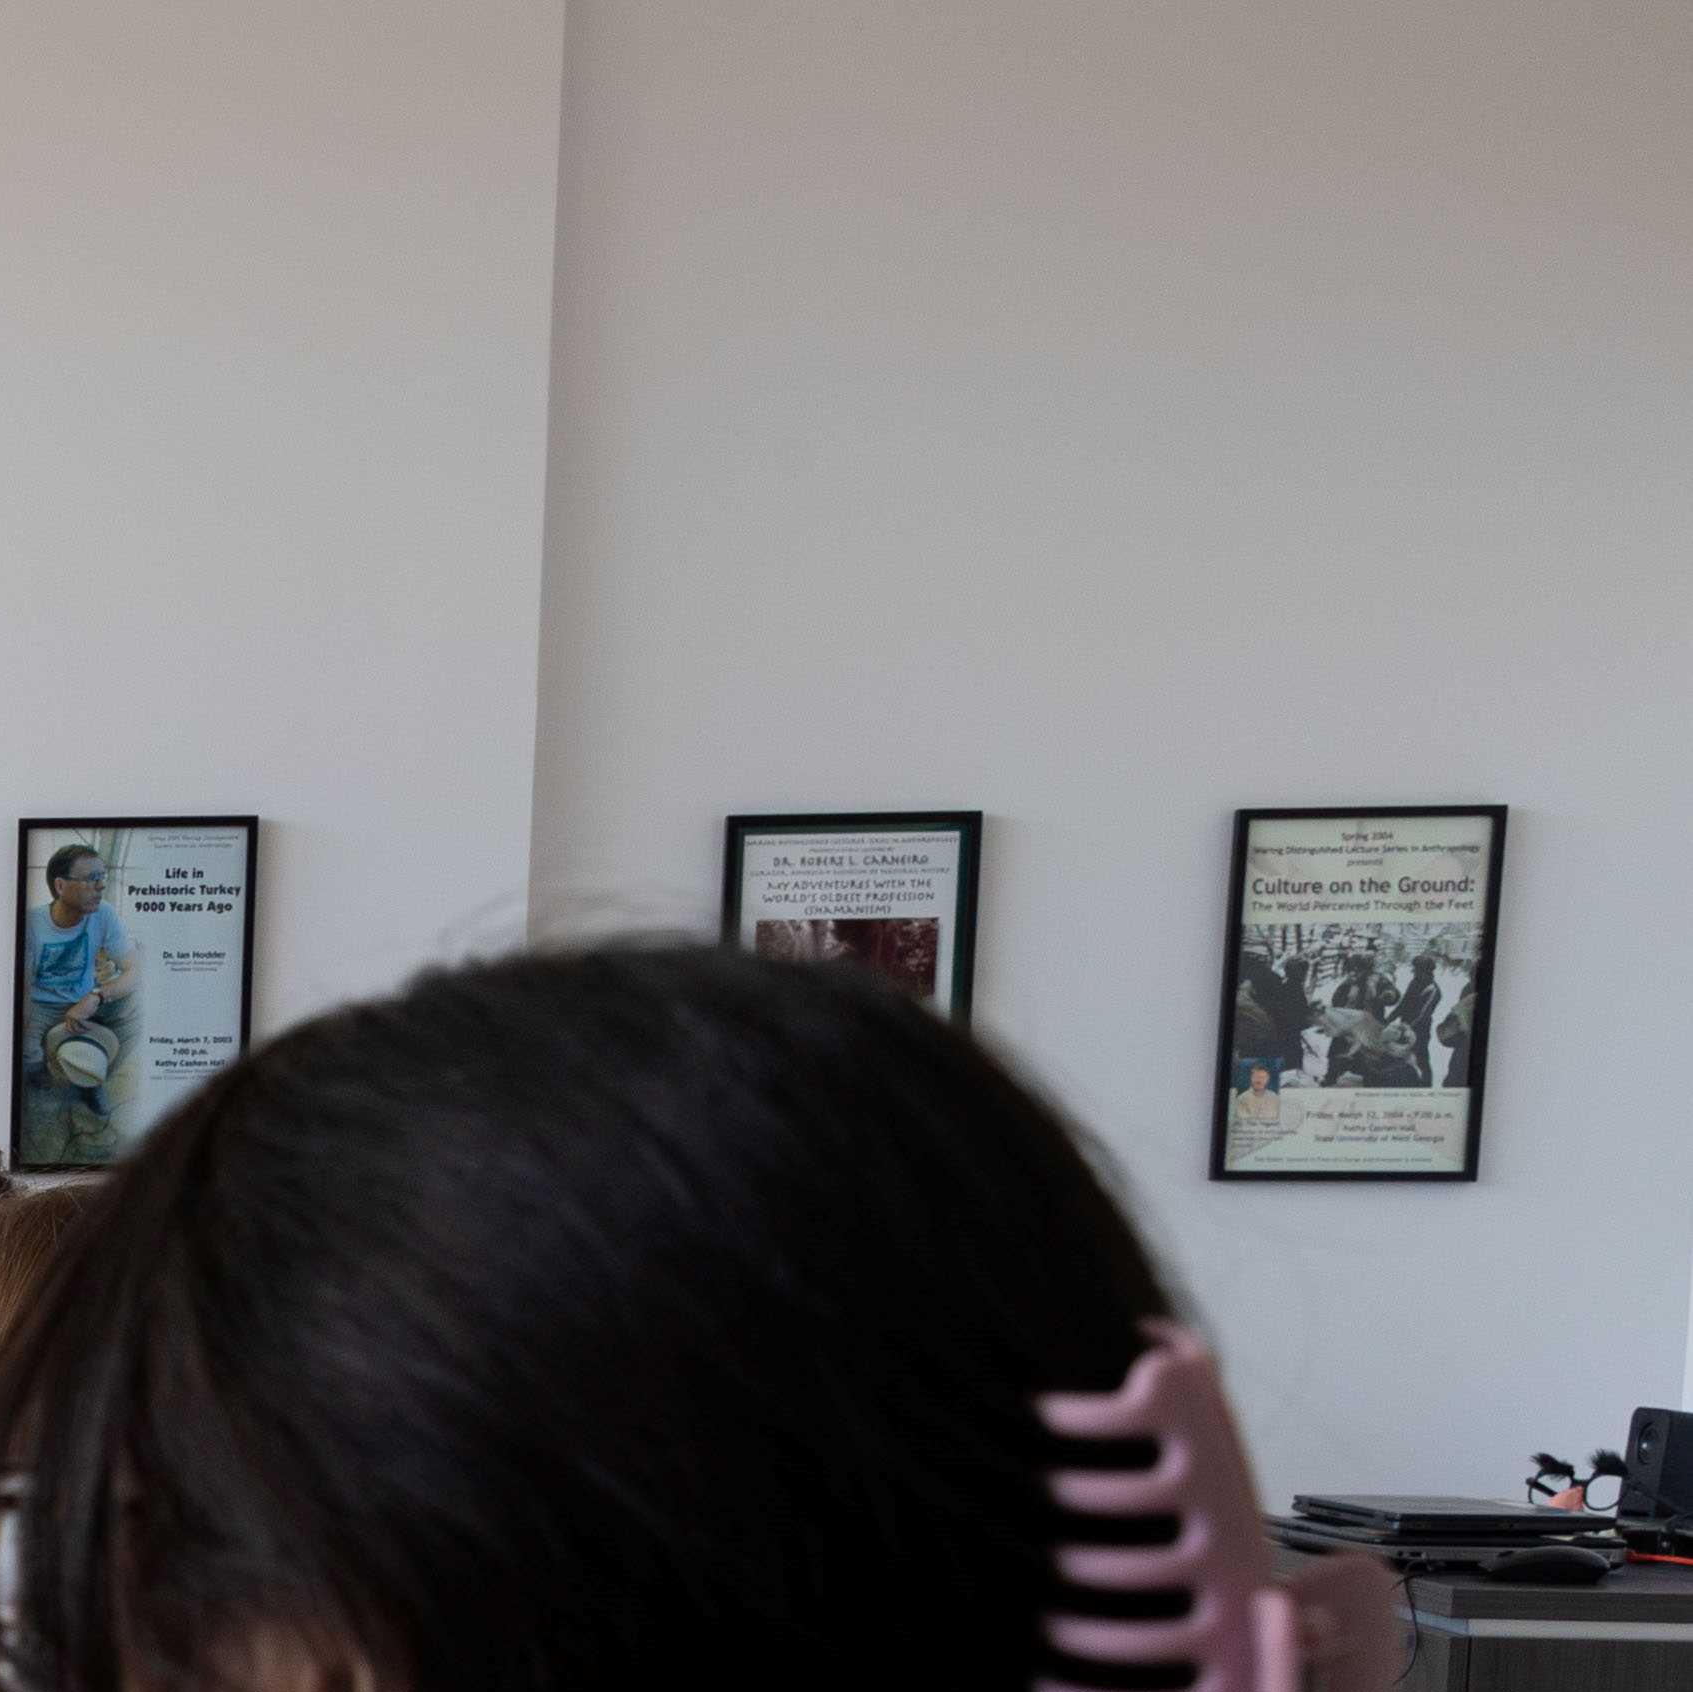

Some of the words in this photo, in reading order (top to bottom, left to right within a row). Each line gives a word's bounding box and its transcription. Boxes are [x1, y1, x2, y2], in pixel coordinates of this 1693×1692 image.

[1341, 832, 1368, 841] Spring
[1286, 847, 1343, 856] Distinguished
[1345, 846, 1379, 854] Lecture
[1381, 846, 1408, 854] Series
[1422, 845, 1480, 855] Anthropology
[800, 855, 845, 866] ROBERT
[862, 854, 929, 866] CARNEIRO
[165, 867, 189, 879] Life
[192, 867, 204, 879] in
[792, 879, 870, 890] ADVENTURES
[874, 878, 905, 888] WITH
[910, 878, 932, 888] THE
[1252, 878, 1323, 895] Culture
[1329, 880, 1353, 894] on
[1359, 877, 1392, 893] the
[1398, 876, 1475, 893] Ground:
[128, 884, 196, 896] Prehistoric
[199, 884, 241, 897] Turkey
[762, 893, 817, 903] WORLD'S
[820, 892, 861, 902] OLDEST
[865, 892, 935, 902] PROFESSION
[135, 901, 166, 912] 9000
[169, 901, 203, 912] Years
[207, 900, 233, 913] Ago
[804, 904, 892, 915] (SHAMANISM)
[1252, 900, 1272, 911] The
[1276, 900, 1310, 911] World
[1312, 900, 1370, 911] Perceived
[1374, 900, 1421, 912] Through
[1424, 900, 1444, 910] the
[1447, 899, 1474, 910] Feet
[163, 951, 174, 959] Dr.
[192, 951, 226, 959] Hodder
